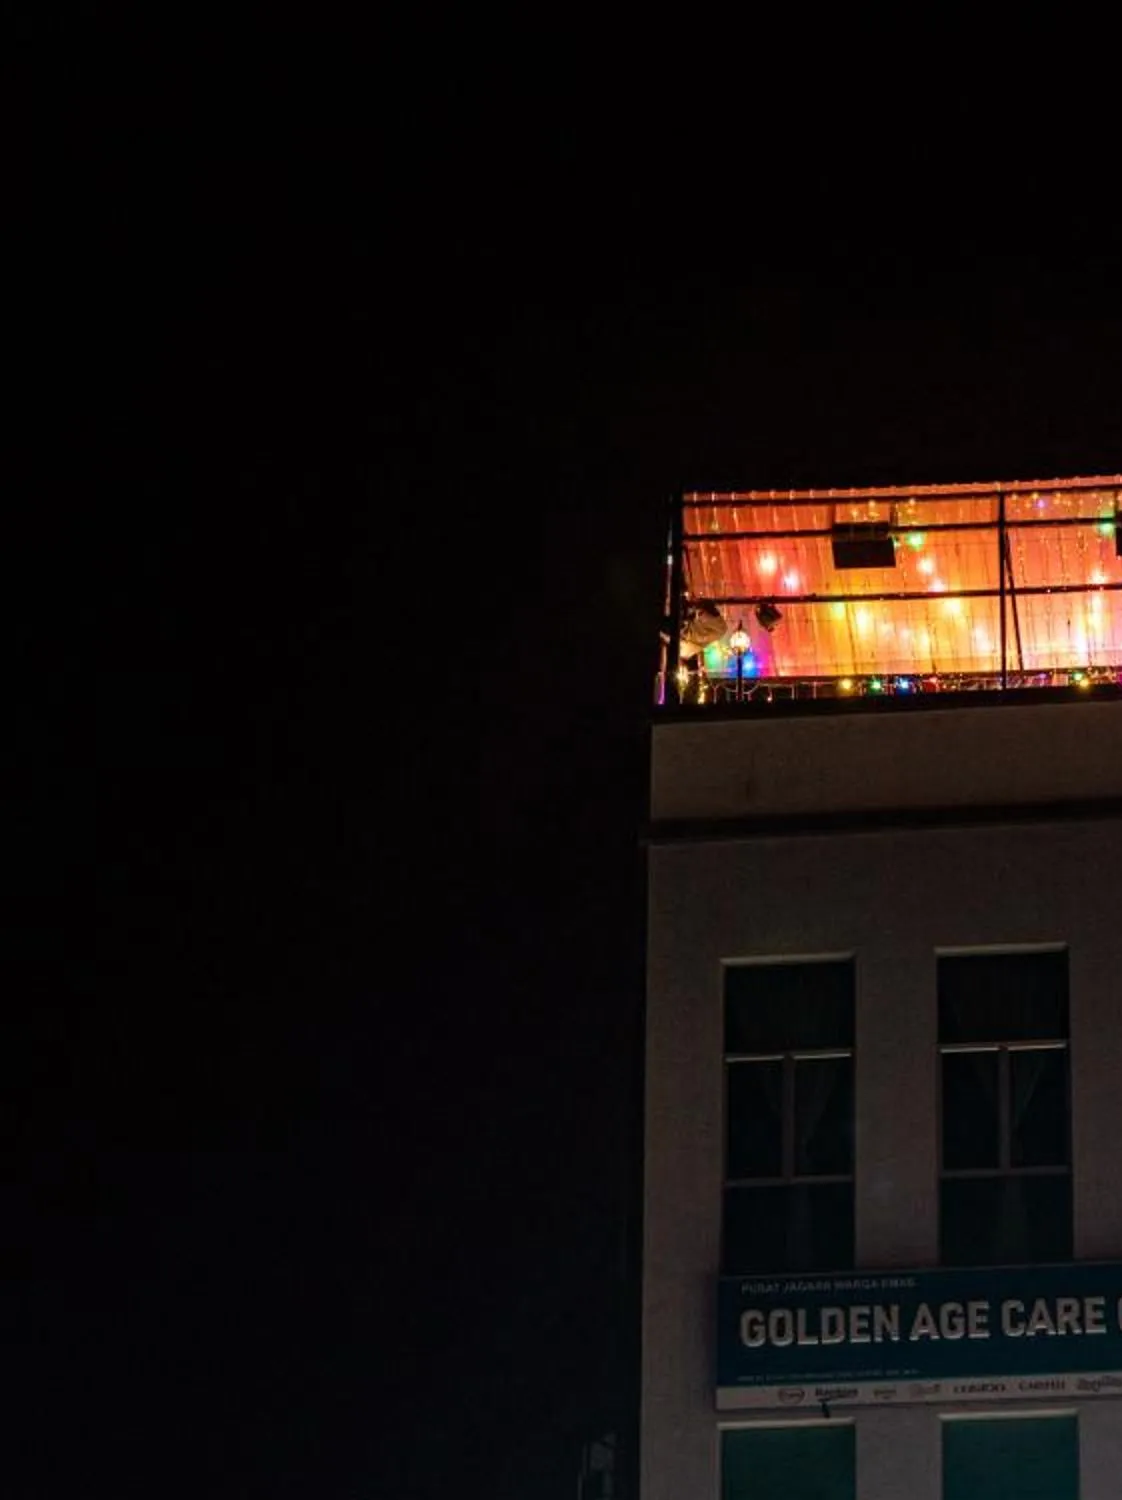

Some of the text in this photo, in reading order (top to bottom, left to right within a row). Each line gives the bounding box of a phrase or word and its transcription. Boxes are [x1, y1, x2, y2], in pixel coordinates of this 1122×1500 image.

[740, 1303, 901, 1347] GOLDEN
[909, 1300, 991, 1340] AGE
[1001, 1296, 1108, 1337] CARE
